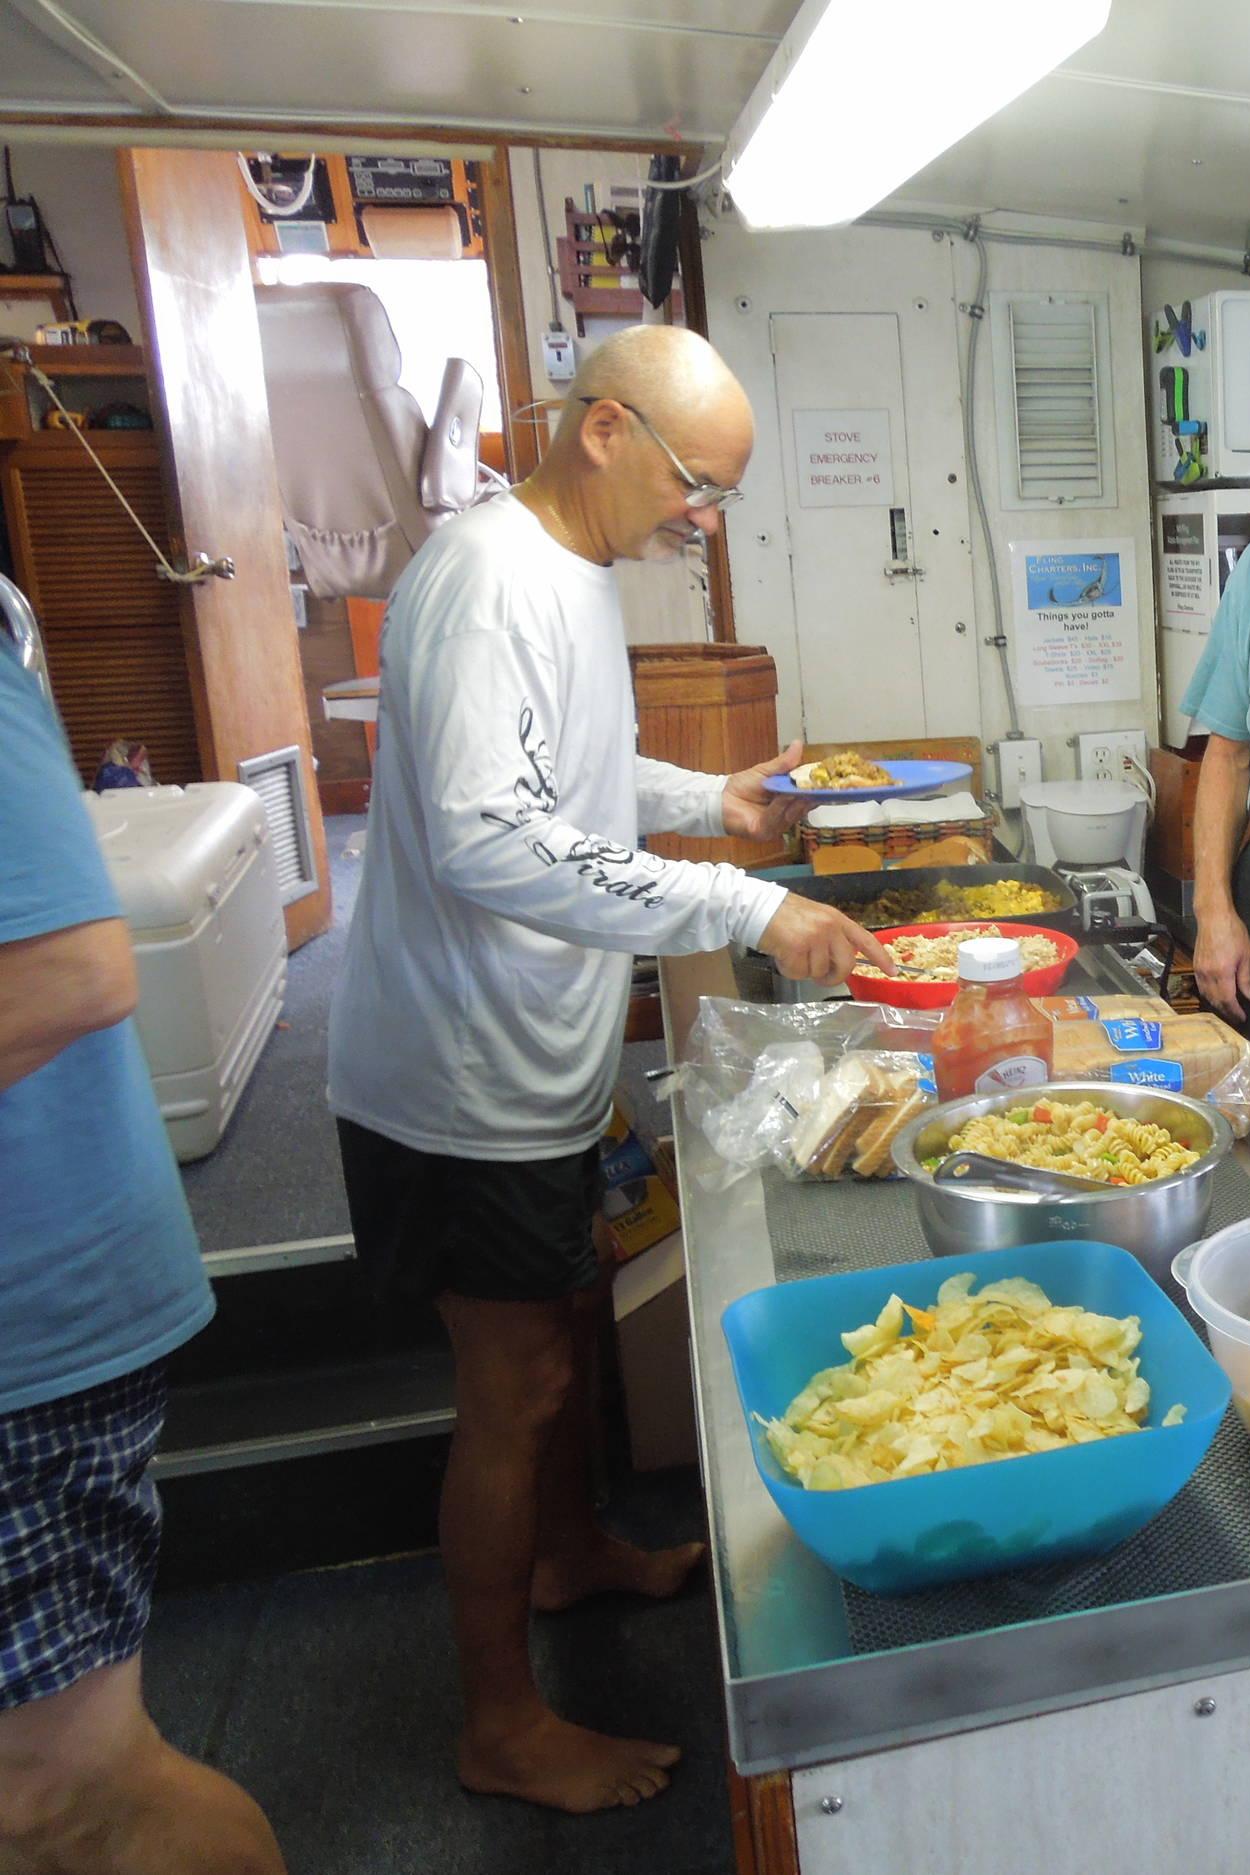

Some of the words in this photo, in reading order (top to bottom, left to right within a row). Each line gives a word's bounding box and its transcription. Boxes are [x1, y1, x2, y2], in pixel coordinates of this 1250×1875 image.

[824, 432, 861, 443] STOVE
[809, 452, 878, 465] EMERGENCY
[810, 474, 862, 486] BREAKER
[1037, 611, 1069, 622] Things
[1071, 611, 1089, 621] you
[1091, 609, 1115, 620] gotta
[1063, 622, 1089, 632] have!
[1128, 1071, 1166, 1083] White
